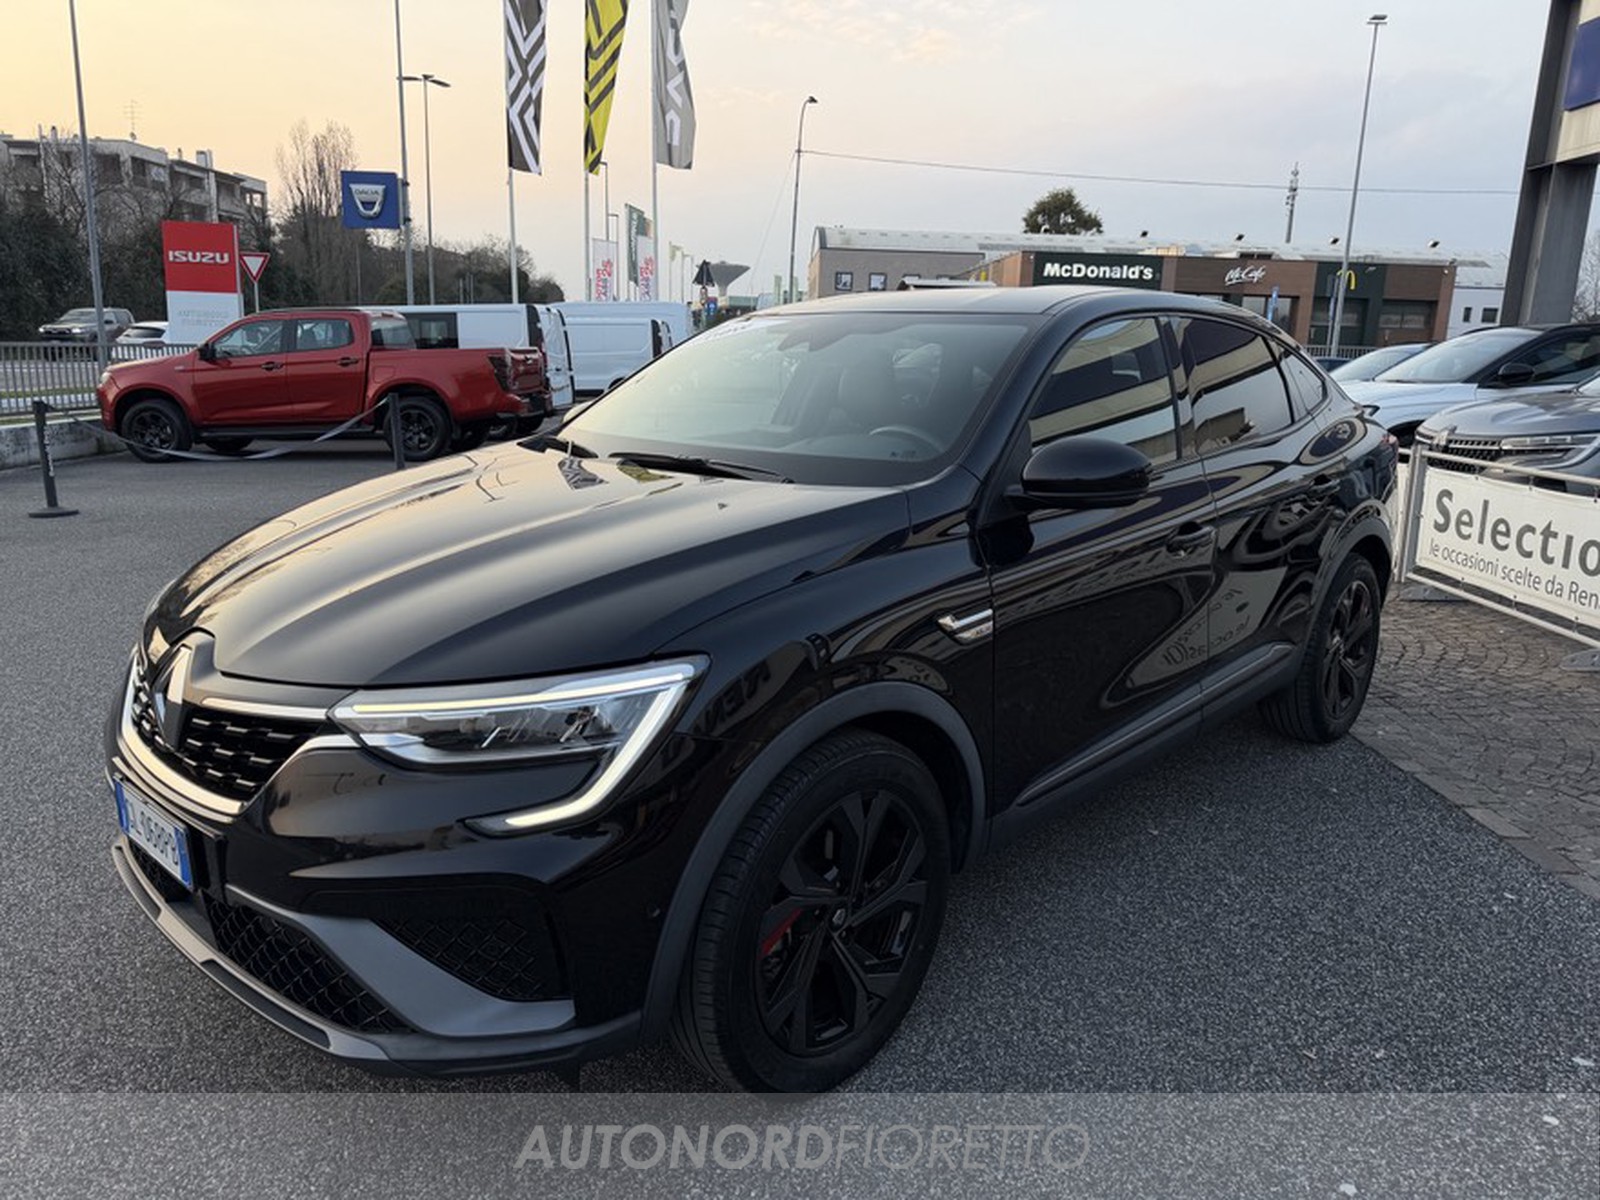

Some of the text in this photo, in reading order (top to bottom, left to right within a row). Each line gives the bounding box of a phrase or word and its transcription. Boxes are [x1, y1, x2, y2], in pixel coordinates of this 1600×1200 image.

[168, 250, 230, 264] ISUZU
[1043, 263, 1154, 280] McDonald's
[1433, 488, 1600, 577] Selectio
[1429, 538, 1600, 610] le occasioni scelte da Ren
